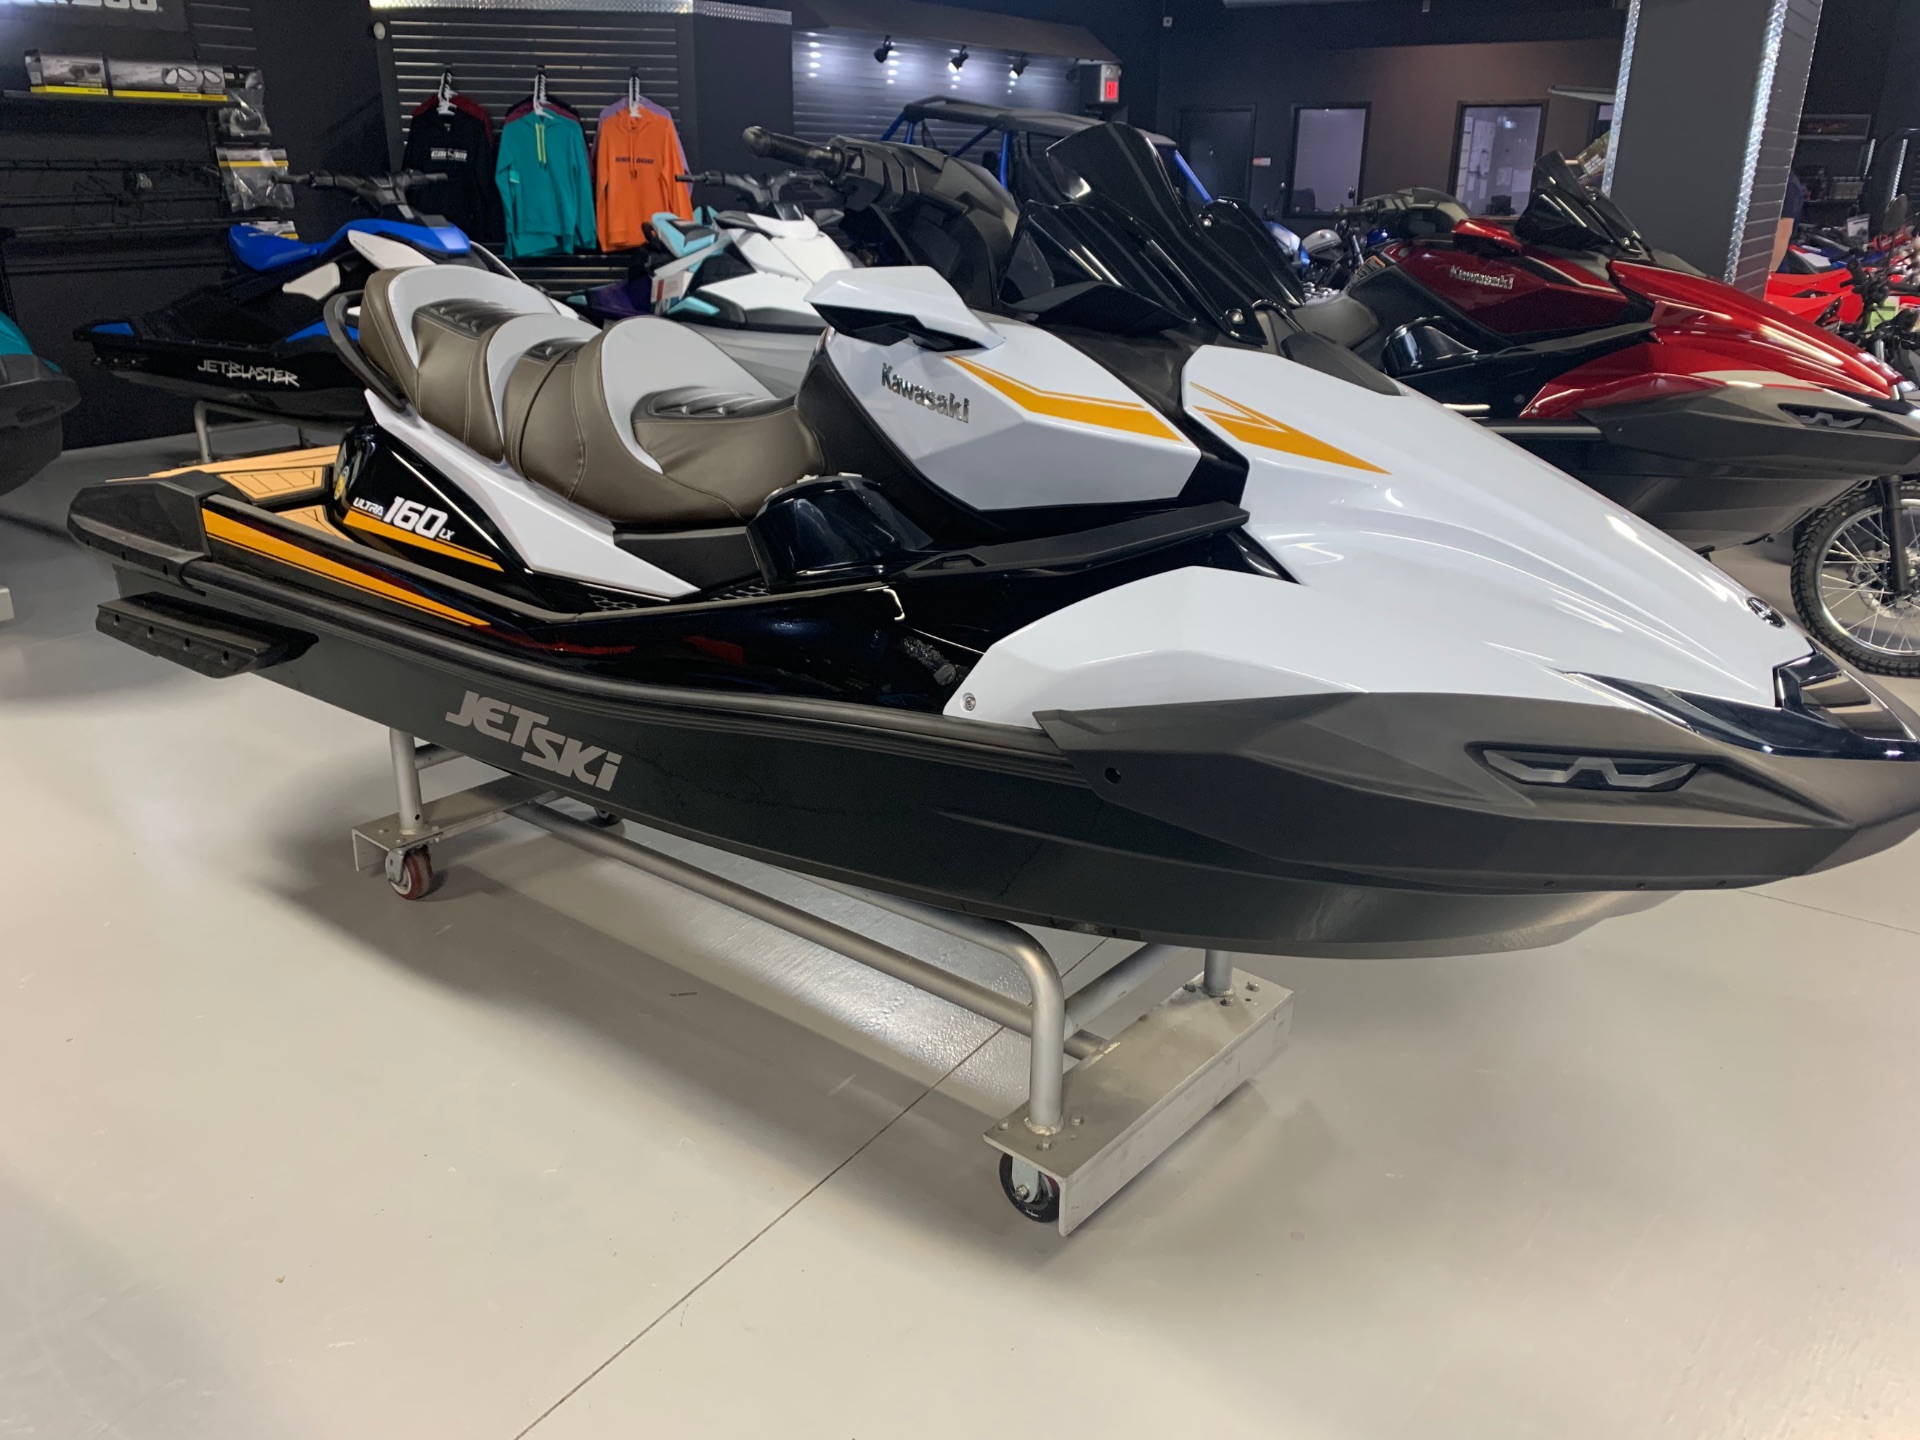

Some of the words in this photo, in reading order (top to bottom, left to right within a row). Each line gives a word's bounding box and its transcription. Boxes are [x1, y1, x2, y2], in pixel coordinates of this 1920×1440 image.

[881, 362, 970, 423] Kawasaki
[352, 496, 384, 517] ULTRA
[382, 495, 449, 540] 160
[438, 527, 455, 541] LX
